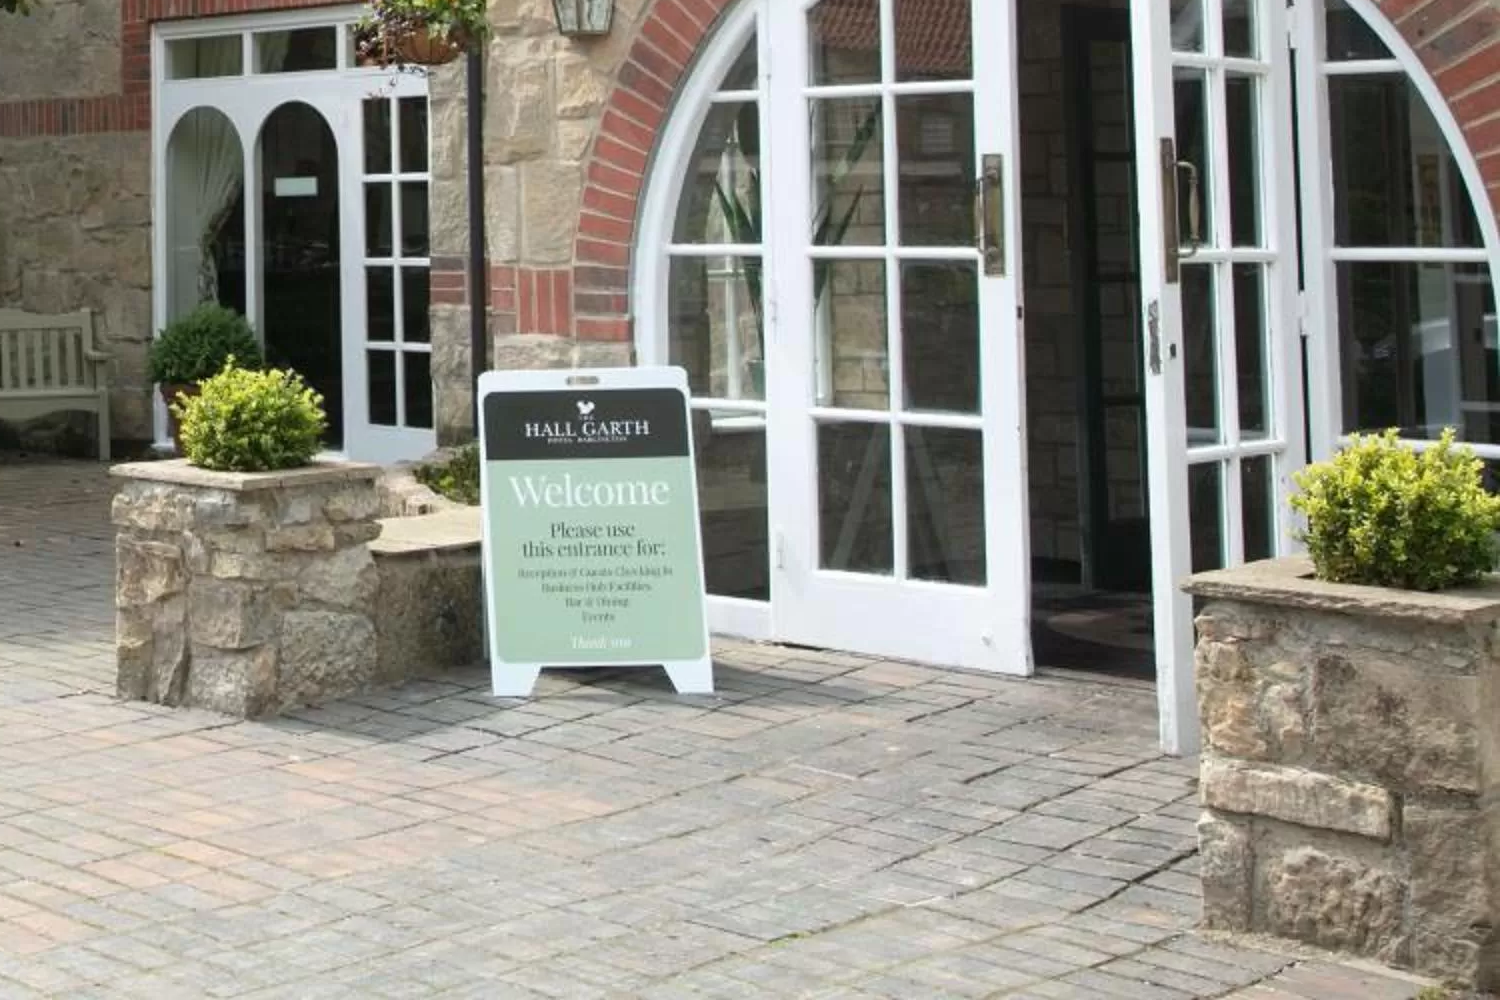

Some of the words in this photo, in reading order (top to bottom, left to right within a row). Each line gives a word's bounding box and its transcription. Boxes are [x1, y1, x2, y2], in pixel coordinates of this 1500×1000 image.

[525, 421, 577, 437] HALL
[582, 420, 650, 436] GARTH
[509, 473, 671, 508] Welcome
[551, 521, 604, 539] Please
[606, 523, 636, 537] use
[522, 541, 553, 558] this
[557, 541, 633, 557] entrance
[636, 539, 666, 557] for:
